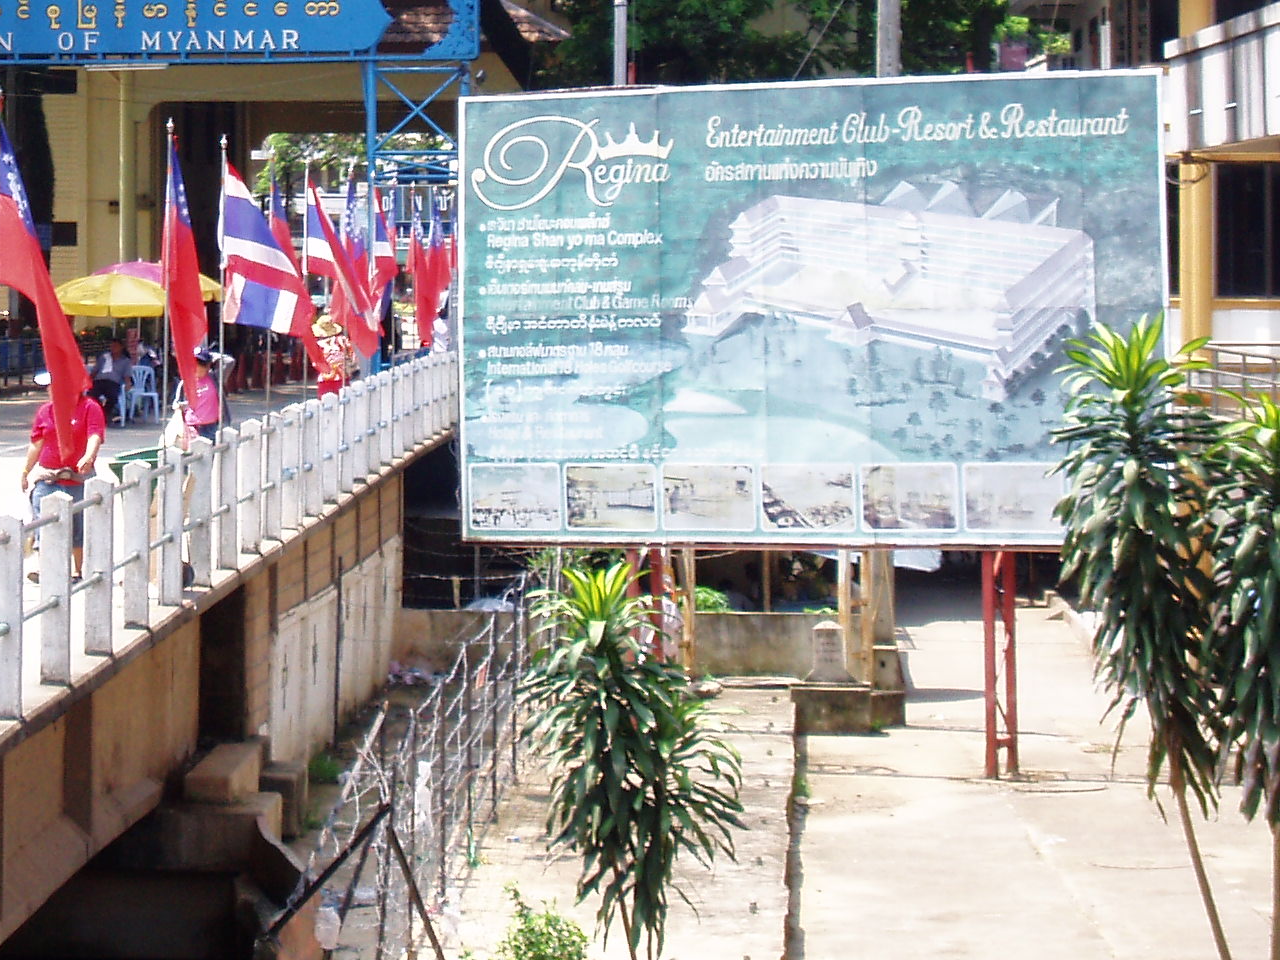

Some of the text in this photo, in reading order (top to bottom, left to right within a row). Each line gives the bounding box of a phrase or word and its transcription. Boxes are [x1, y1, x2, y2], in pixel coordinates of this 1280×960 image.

[57, 30, 101, 52] OF
[140, 28, 300, 51] MYANMAR
[705, 116, 839, 148] Entertainment
[978, 112, 999, 139] &
[1000, 103, 1130, 139] Restaurant
[471, 115, 671, 211] Regina
[487, 229, 664, 251] Regina Shan yo ma Complex
[574, 294, 600, 310] Club
[601, 294, 612, 309] &
[612, 292, 648, 310] Game
[487, 360, 557, 376] International
